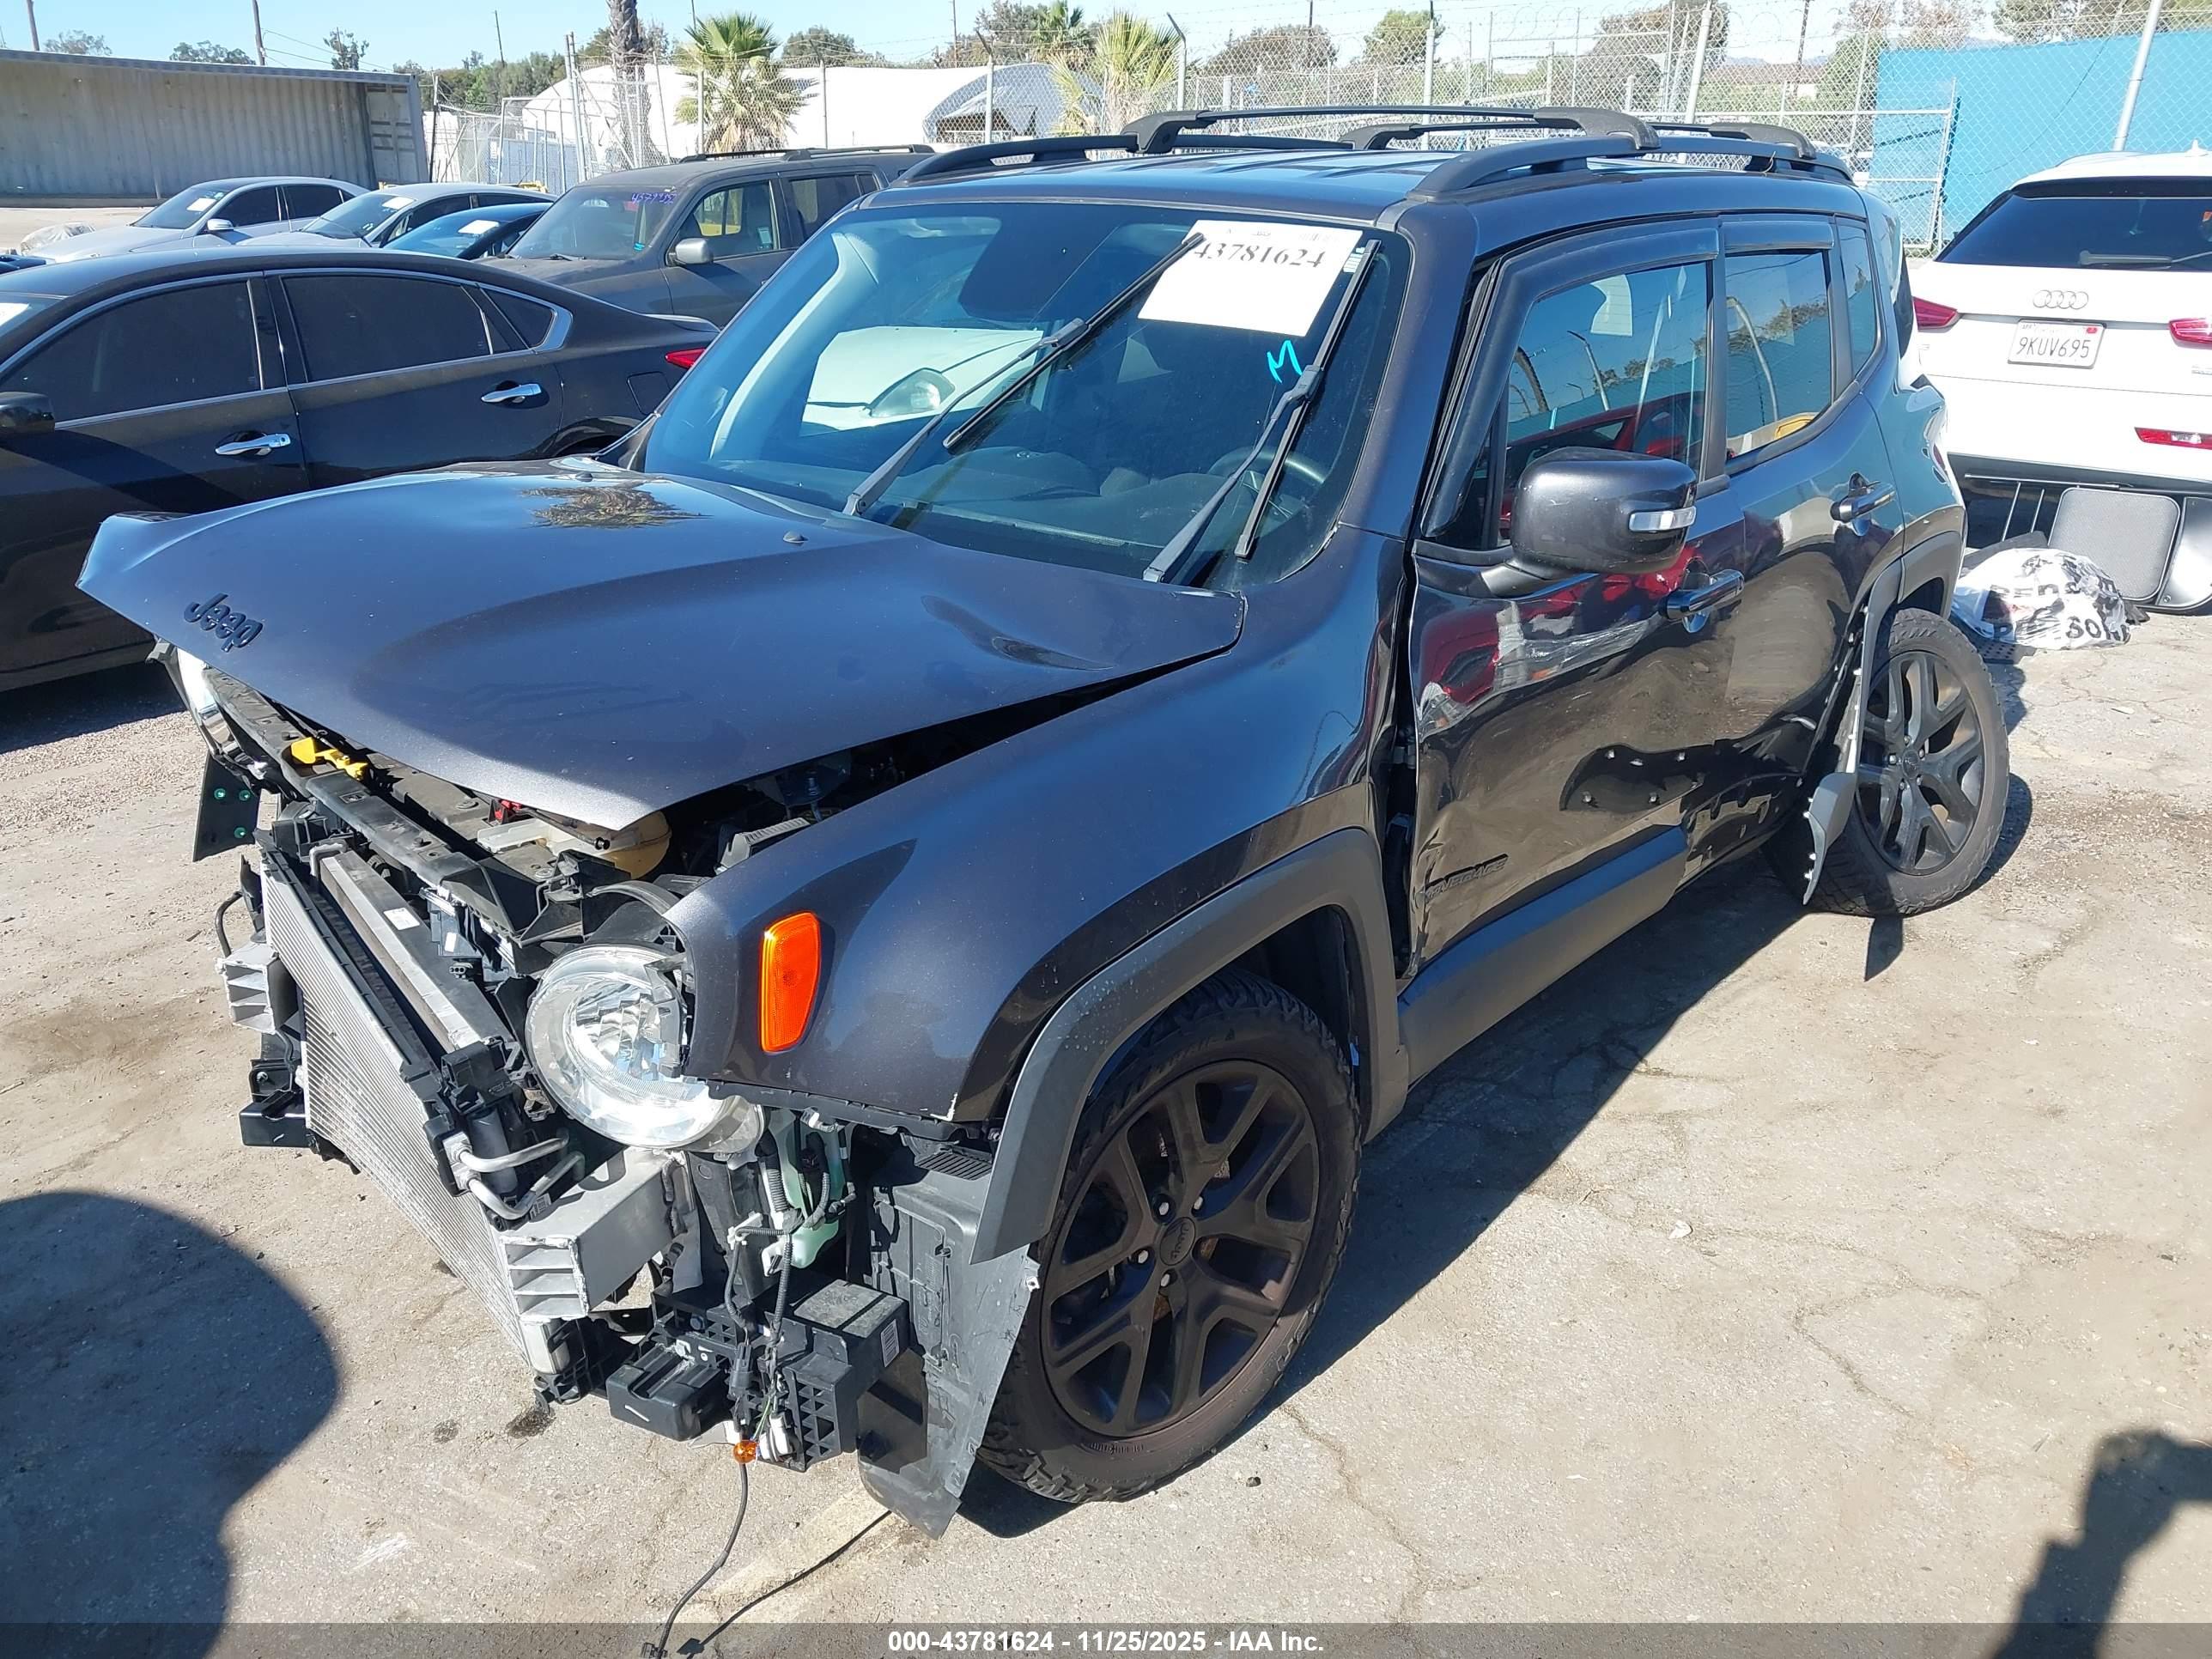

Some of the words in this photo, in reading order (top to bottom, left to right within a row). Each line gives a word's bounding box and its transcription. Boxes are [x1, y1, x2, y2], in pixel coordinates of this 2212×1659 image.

[1194, 242, 1325, 267] 43781624
[2016, 337, 2091, 358] 9KUV695
[184, 592, 264, 653] Jeep
